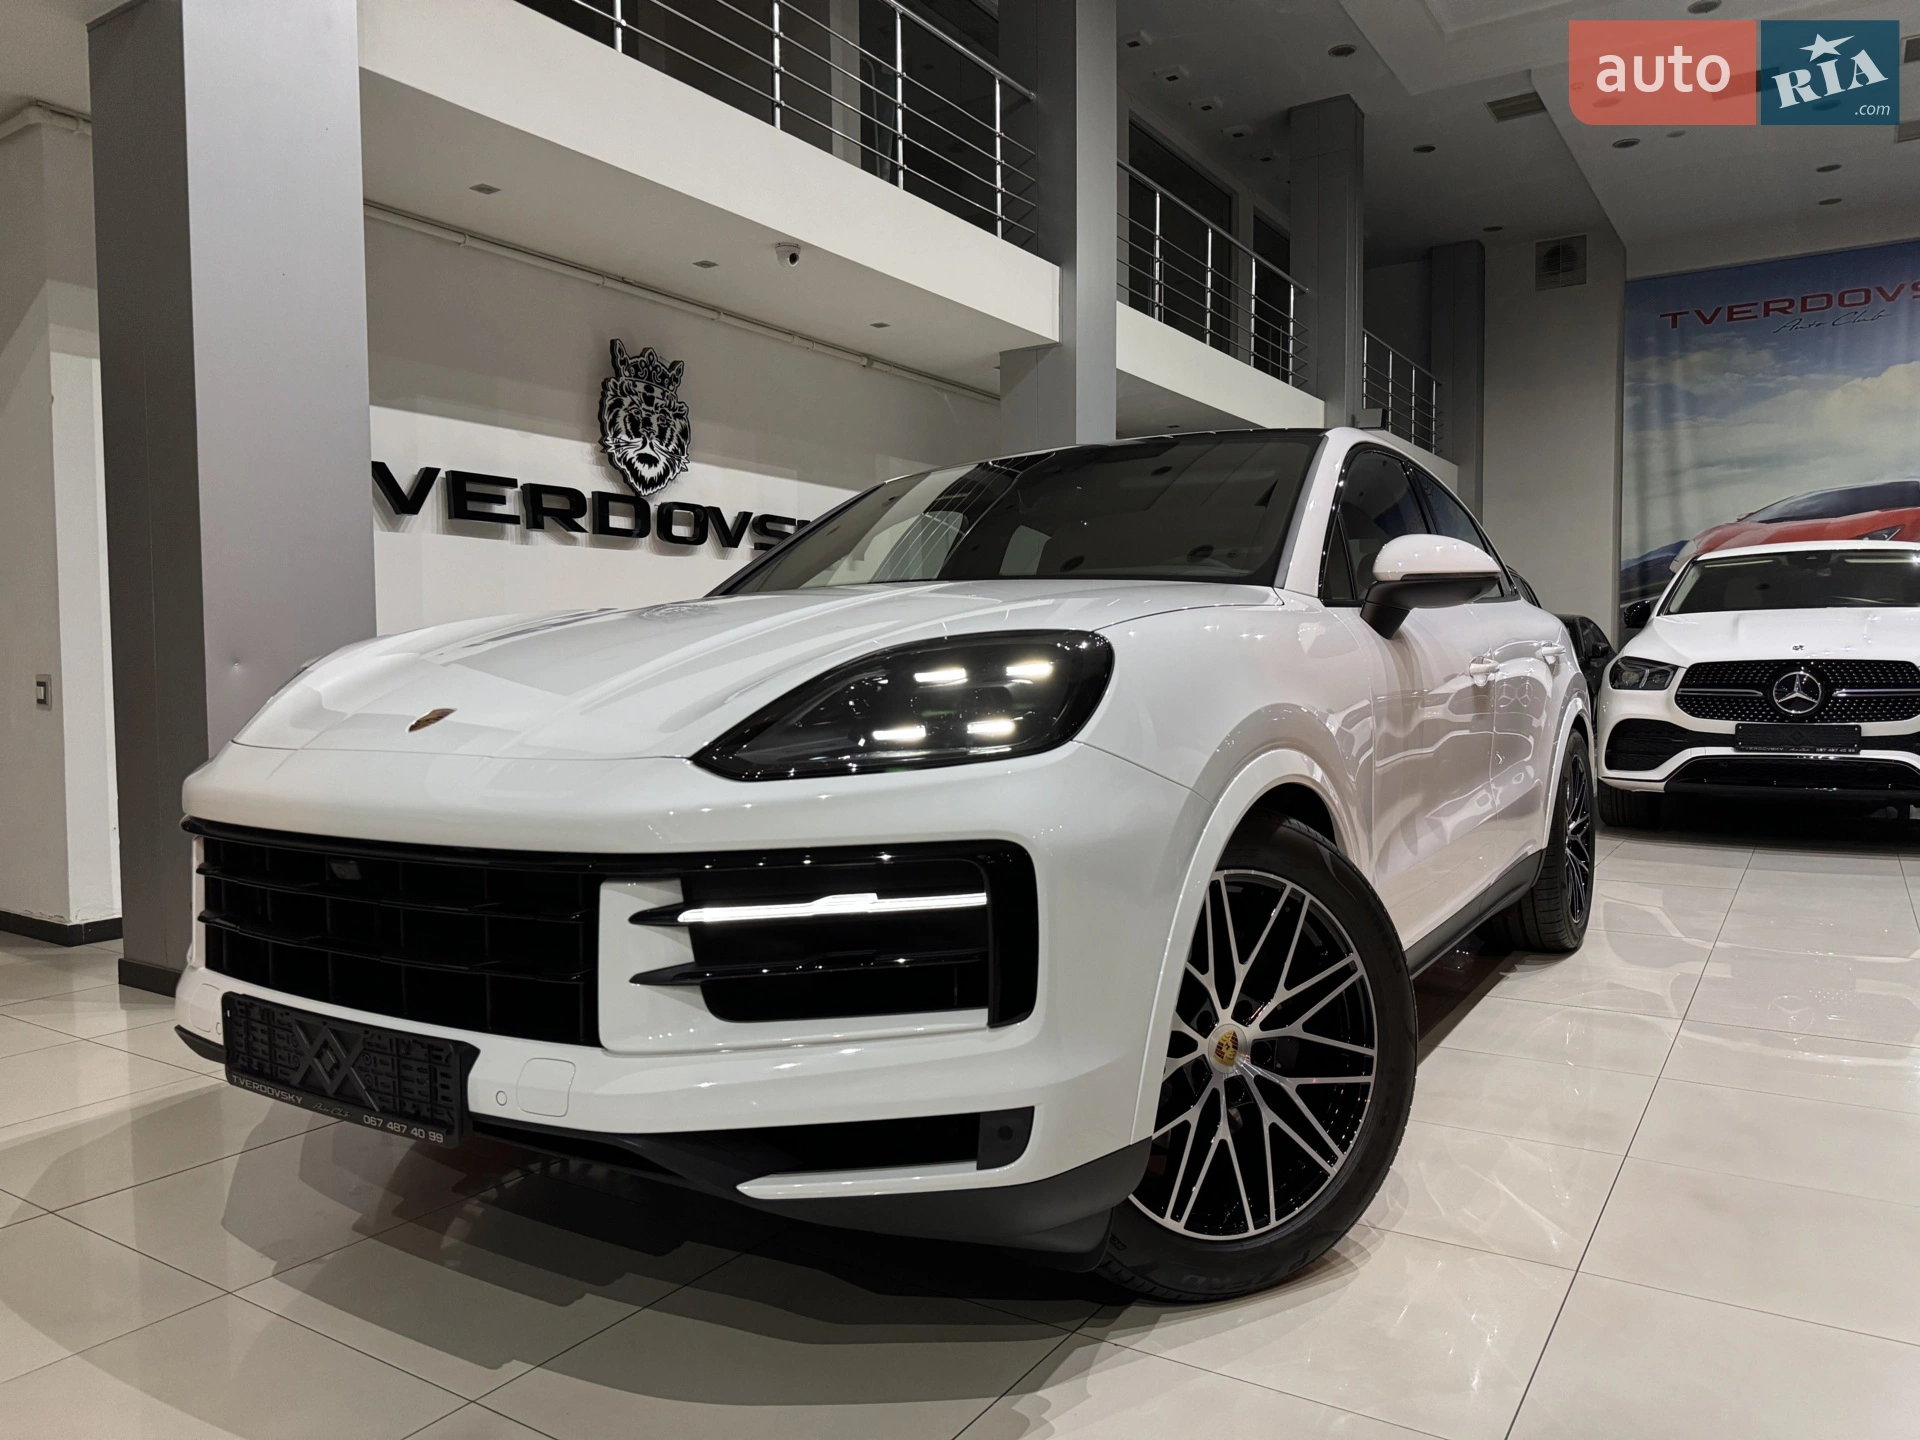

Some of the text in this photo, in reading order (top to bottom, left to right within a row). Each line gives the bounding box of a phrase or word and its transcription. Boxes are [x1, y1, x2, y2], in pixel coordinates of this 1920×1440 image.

[372, 461, 811, 551] VERDOVS
[232, 1075, 303, 1104] TVERDOVSKY
[363, 1114, 383, 1128] 067
[386, 1120, 407, 1134] 487
[410, 1127, 425, 1139] 40
[428, 1131, 444, 1143] 99
